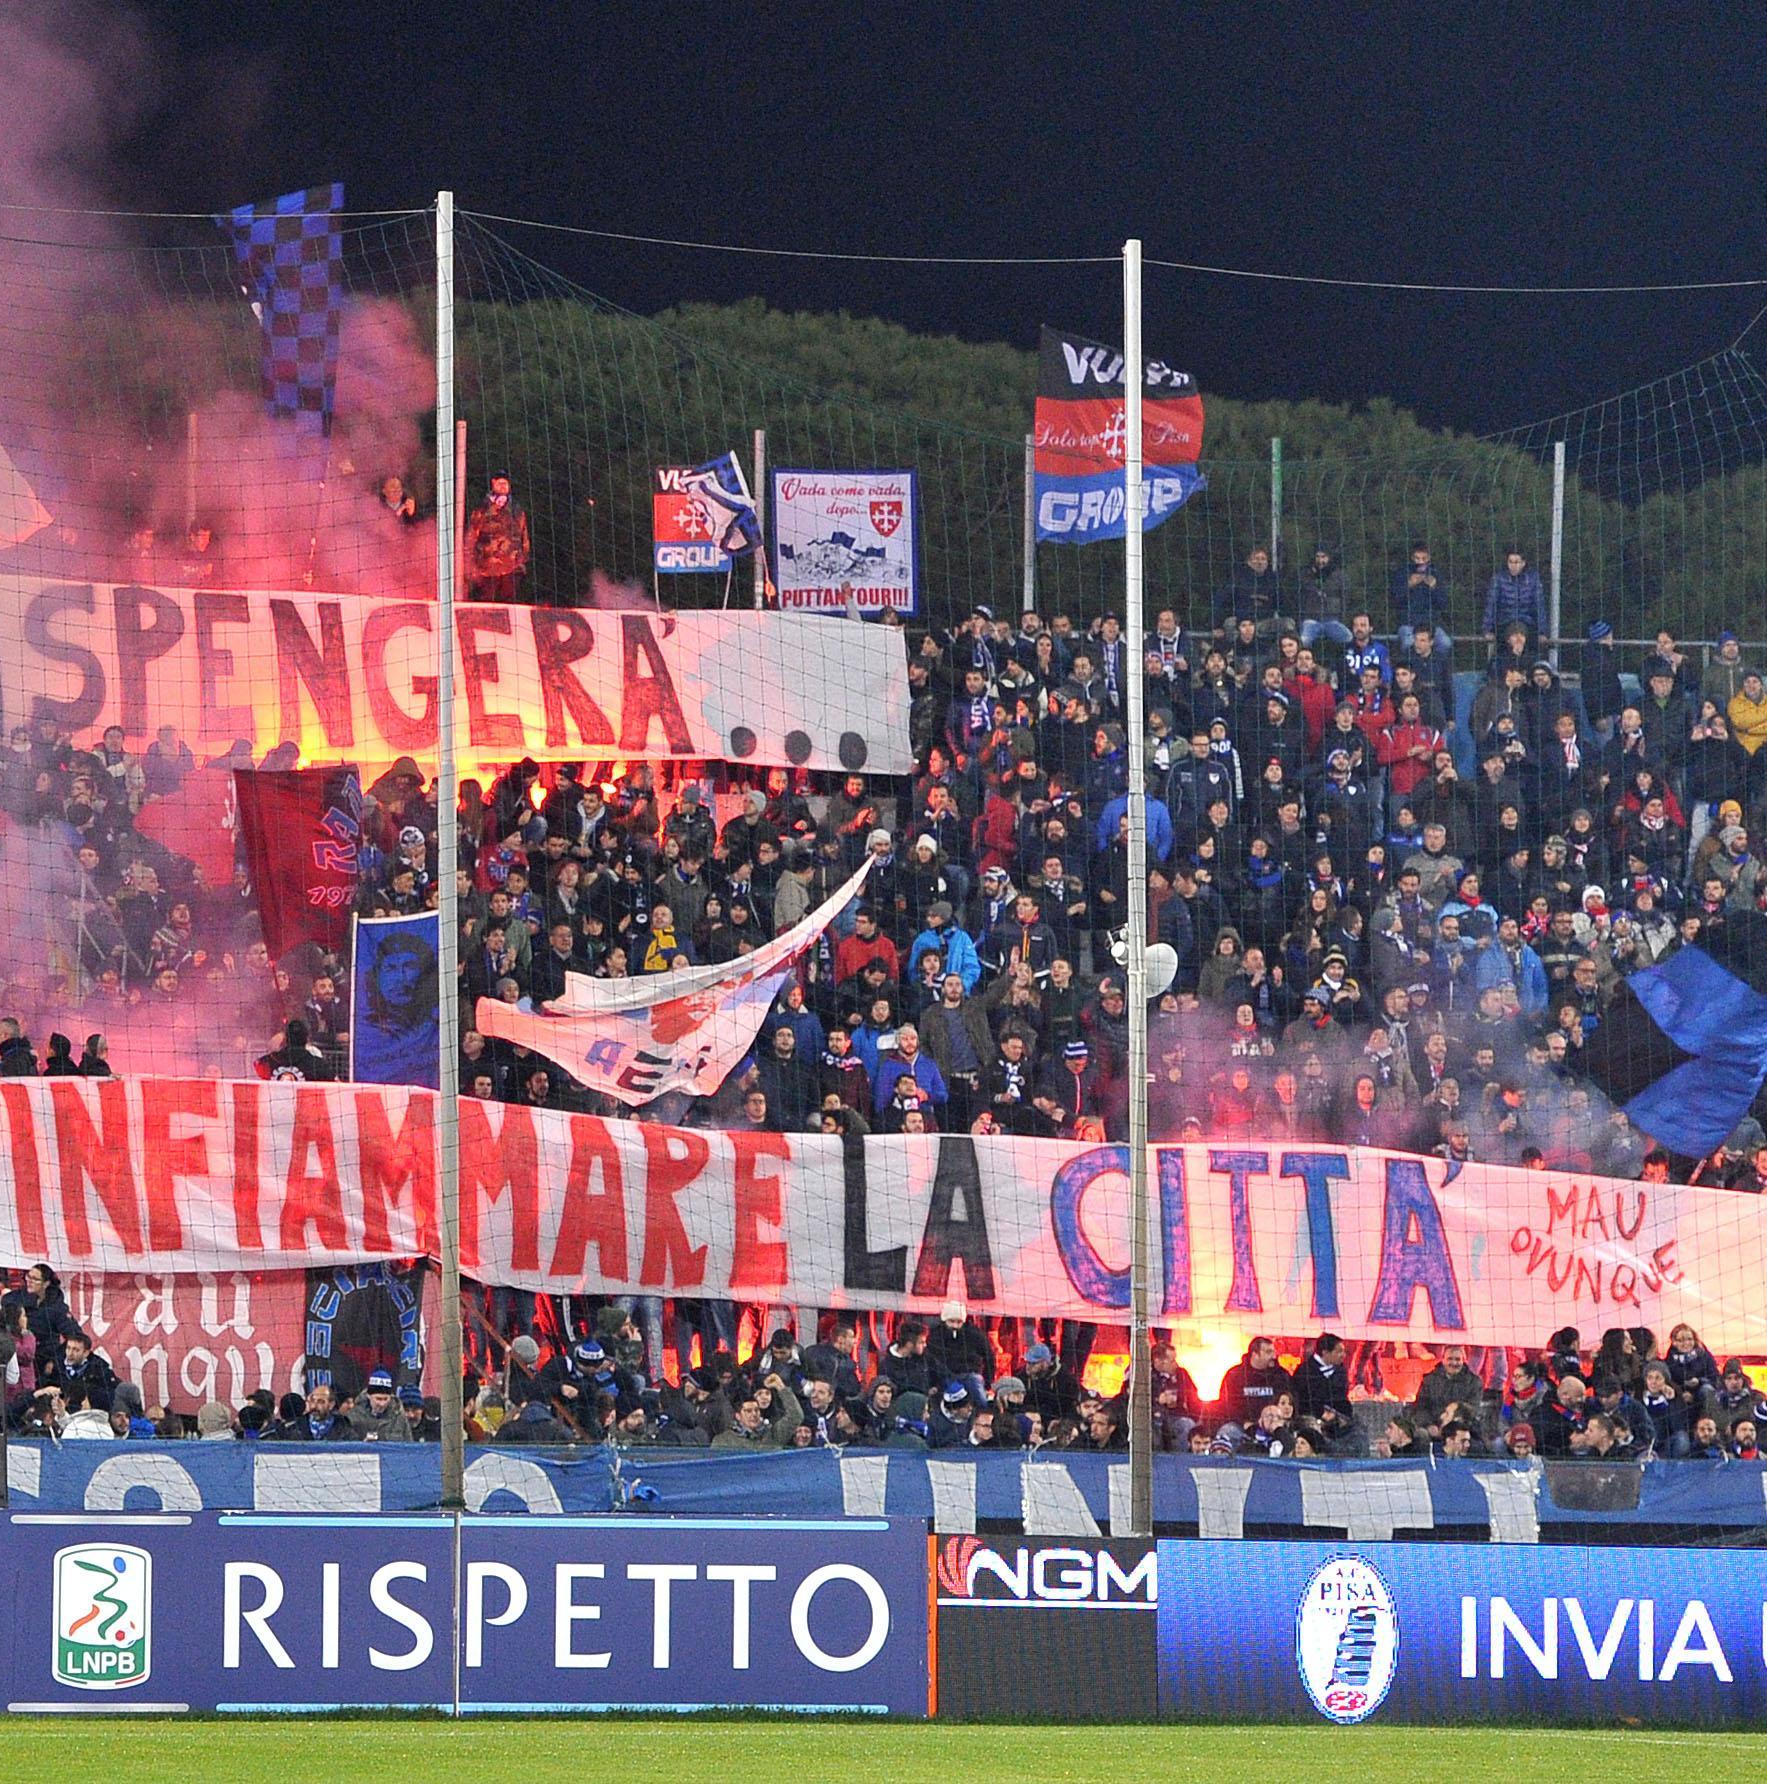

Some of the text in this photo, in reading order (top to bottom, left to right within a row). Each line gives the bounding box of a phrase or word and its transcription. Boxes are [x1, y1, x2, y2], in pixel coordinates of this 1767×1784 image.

[781, 477, 825, 501] Vada
[831, 486, 864, 497] come
[842, 1135, 997, 1300] LA
[1546, 1184, 1647, 1242] MAU
[1511, 1226, 1685, 1309] OVUNQUE
[966, 1548, 1158, 1601] NGM
[1320, 1583, 1377, 1600] PISA
[224, 1560, 891, 1672] RISPETTO
[1460, 1596, 1734, 1683] INVIA
[66, 1649, 136, 1676] LNPB
